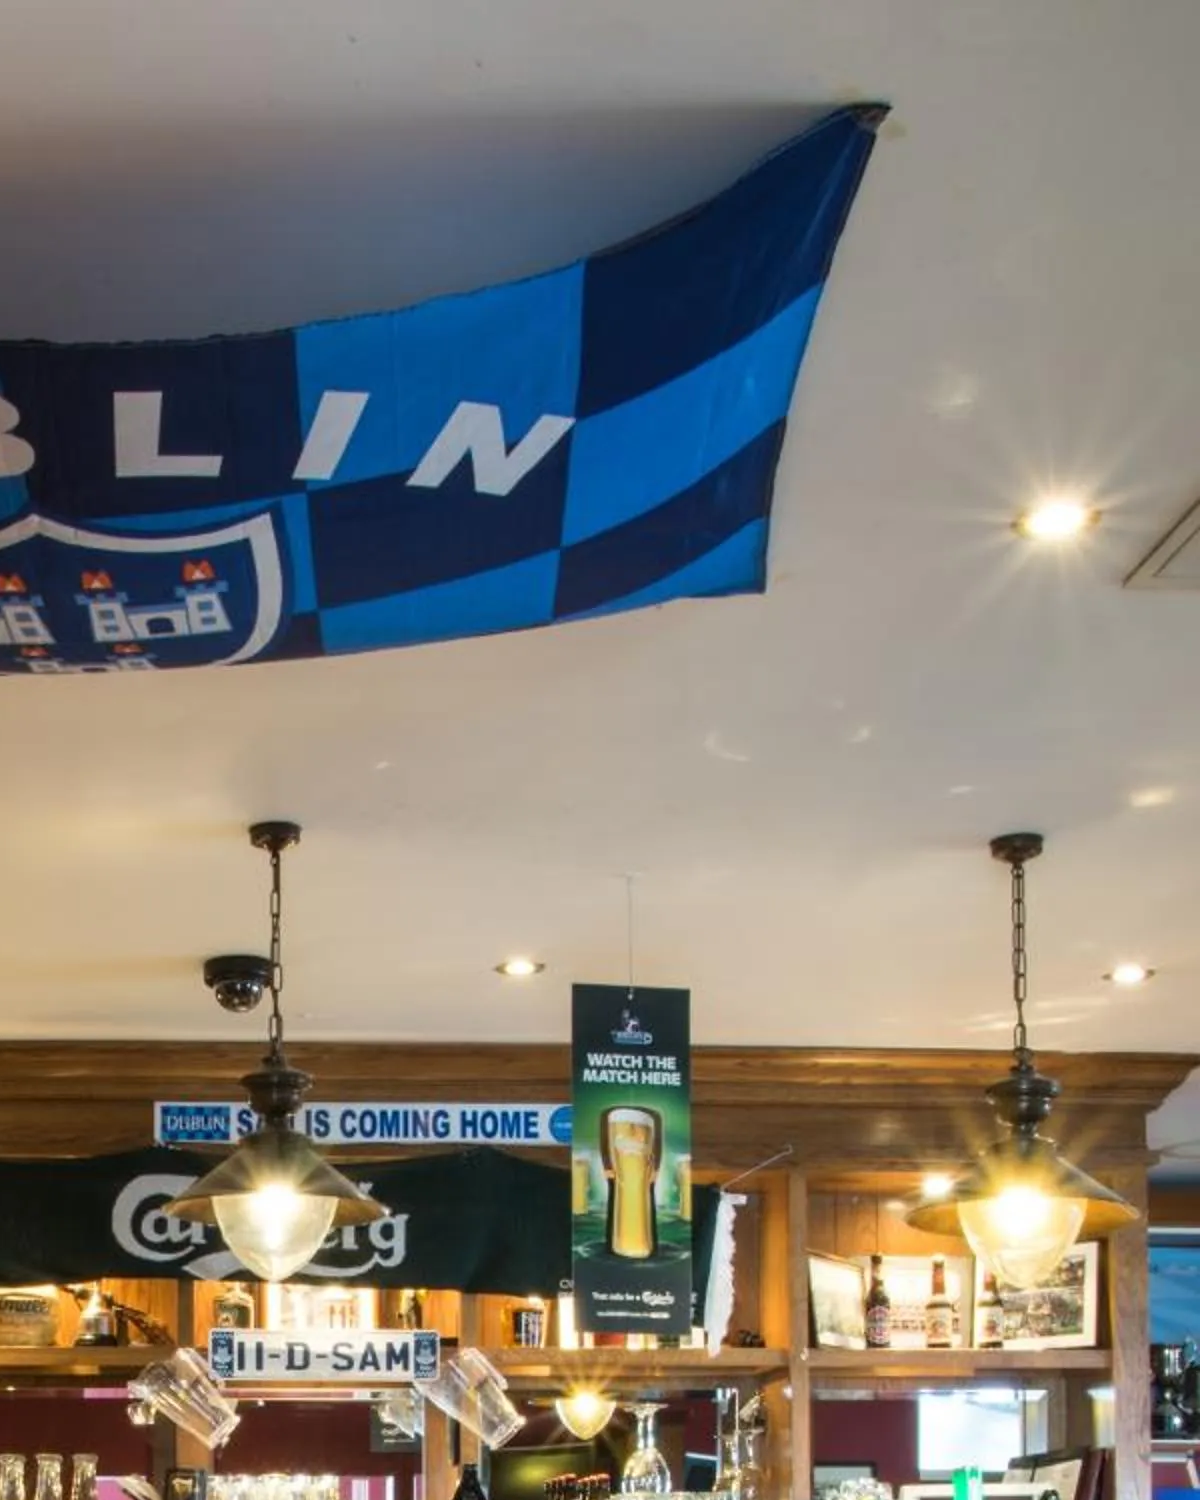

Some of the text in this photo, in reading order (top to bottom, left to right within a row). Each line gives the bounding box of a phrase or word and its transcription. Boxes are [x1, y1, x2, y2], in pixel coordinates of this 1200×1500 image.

[586, 1051, 677, 1071] WATCH THE
[583, 1068, 682, 1087] MATCH HERE
[167, 1114, 226, 1132] DUBLIN
[305, 1109, 332, 1138] IS
[339, 1108, 451, 1139] COMING
[460, 1110, 540, 1139] HOME
[112, 1174, 410, 1279] Carerg
